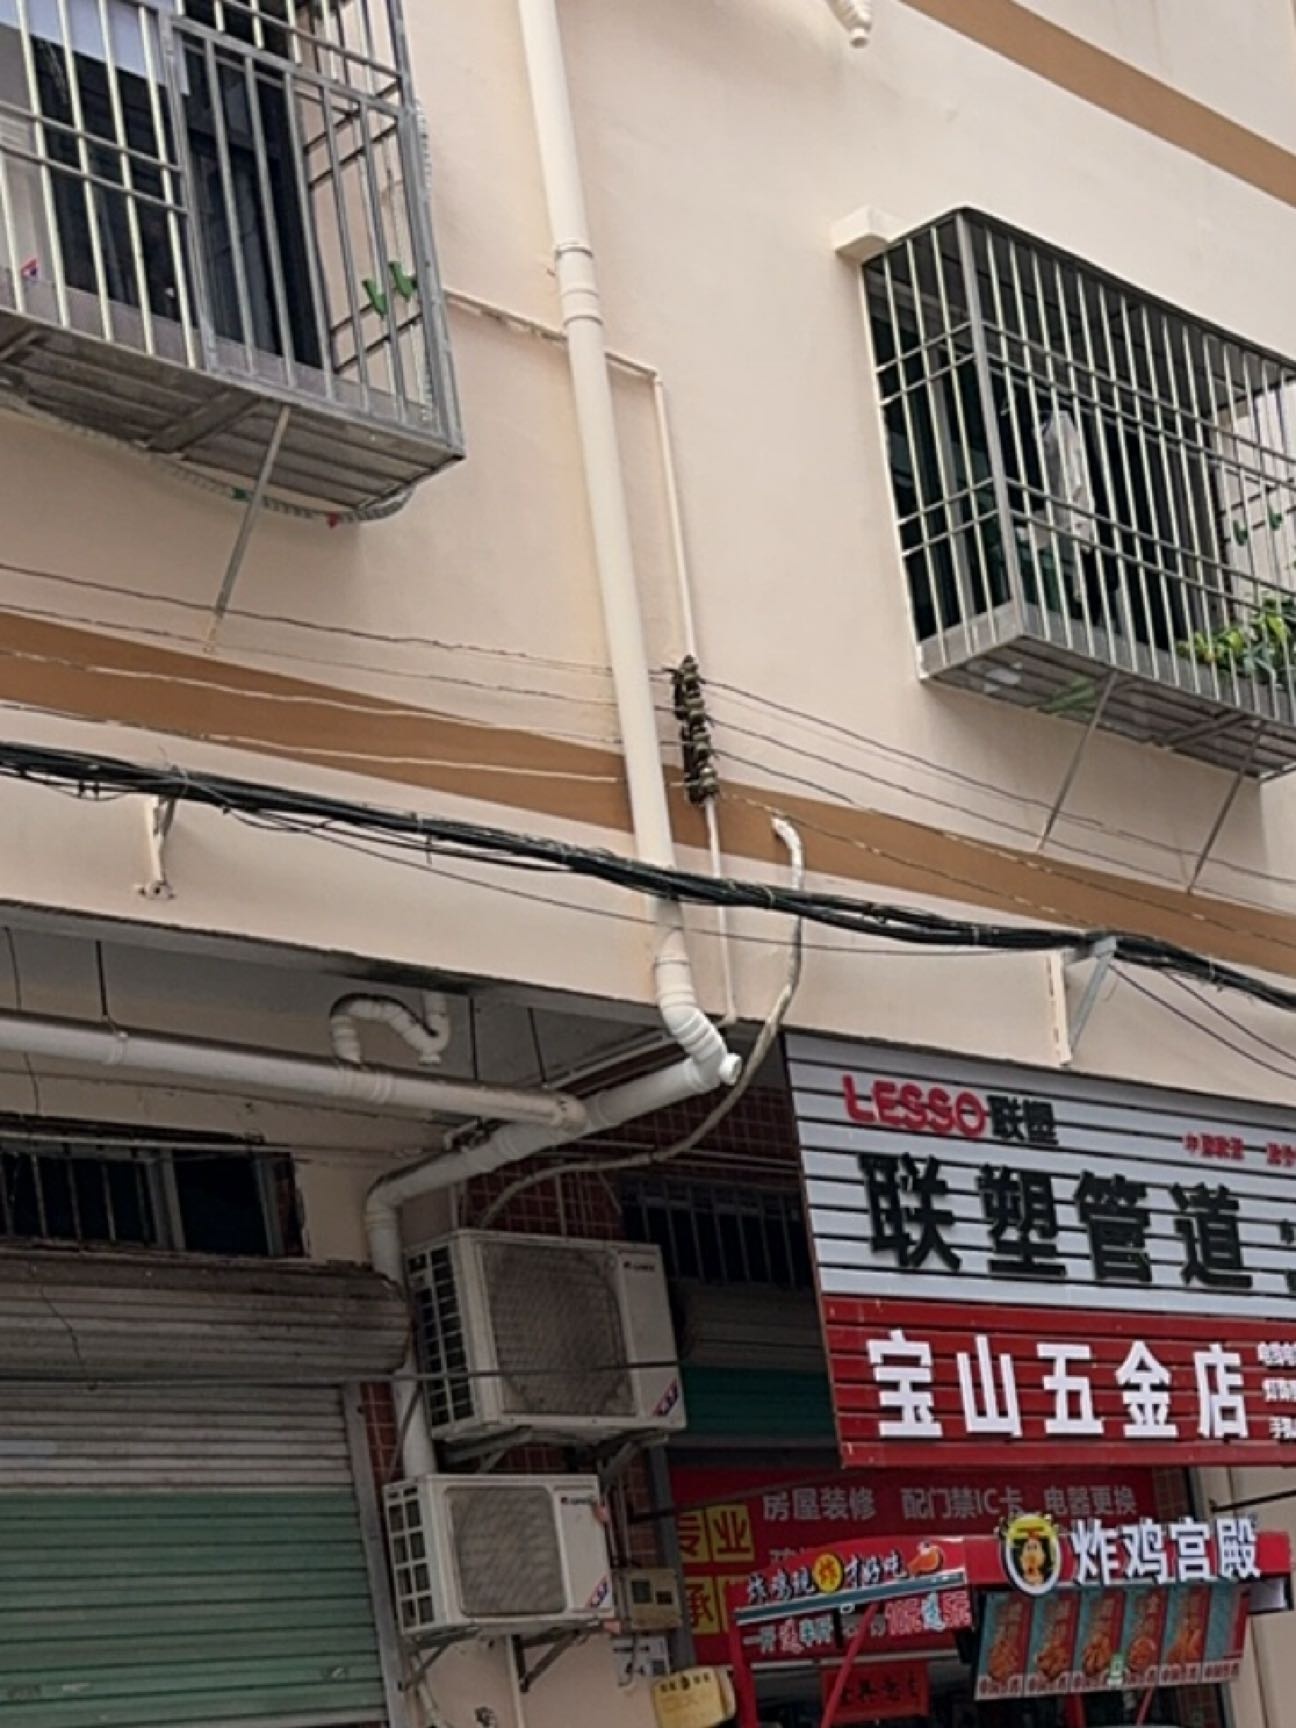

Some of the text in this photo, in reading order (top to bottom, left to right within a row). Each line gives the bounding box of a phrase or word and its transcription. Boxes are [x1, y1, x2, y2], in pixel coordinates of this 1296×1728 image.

[842, 1074, 989, 1138] LESSO
[857, 1151, 1253, 1290] 联塑管道
[866, 1328, 1249, 1440] 宝山五金店
[763, 1485, 1137, 1522] 房屋装修 配门禁IC卡 电器更换
[1070, 1516, 1261, 1586] 炸鸡宫殿
